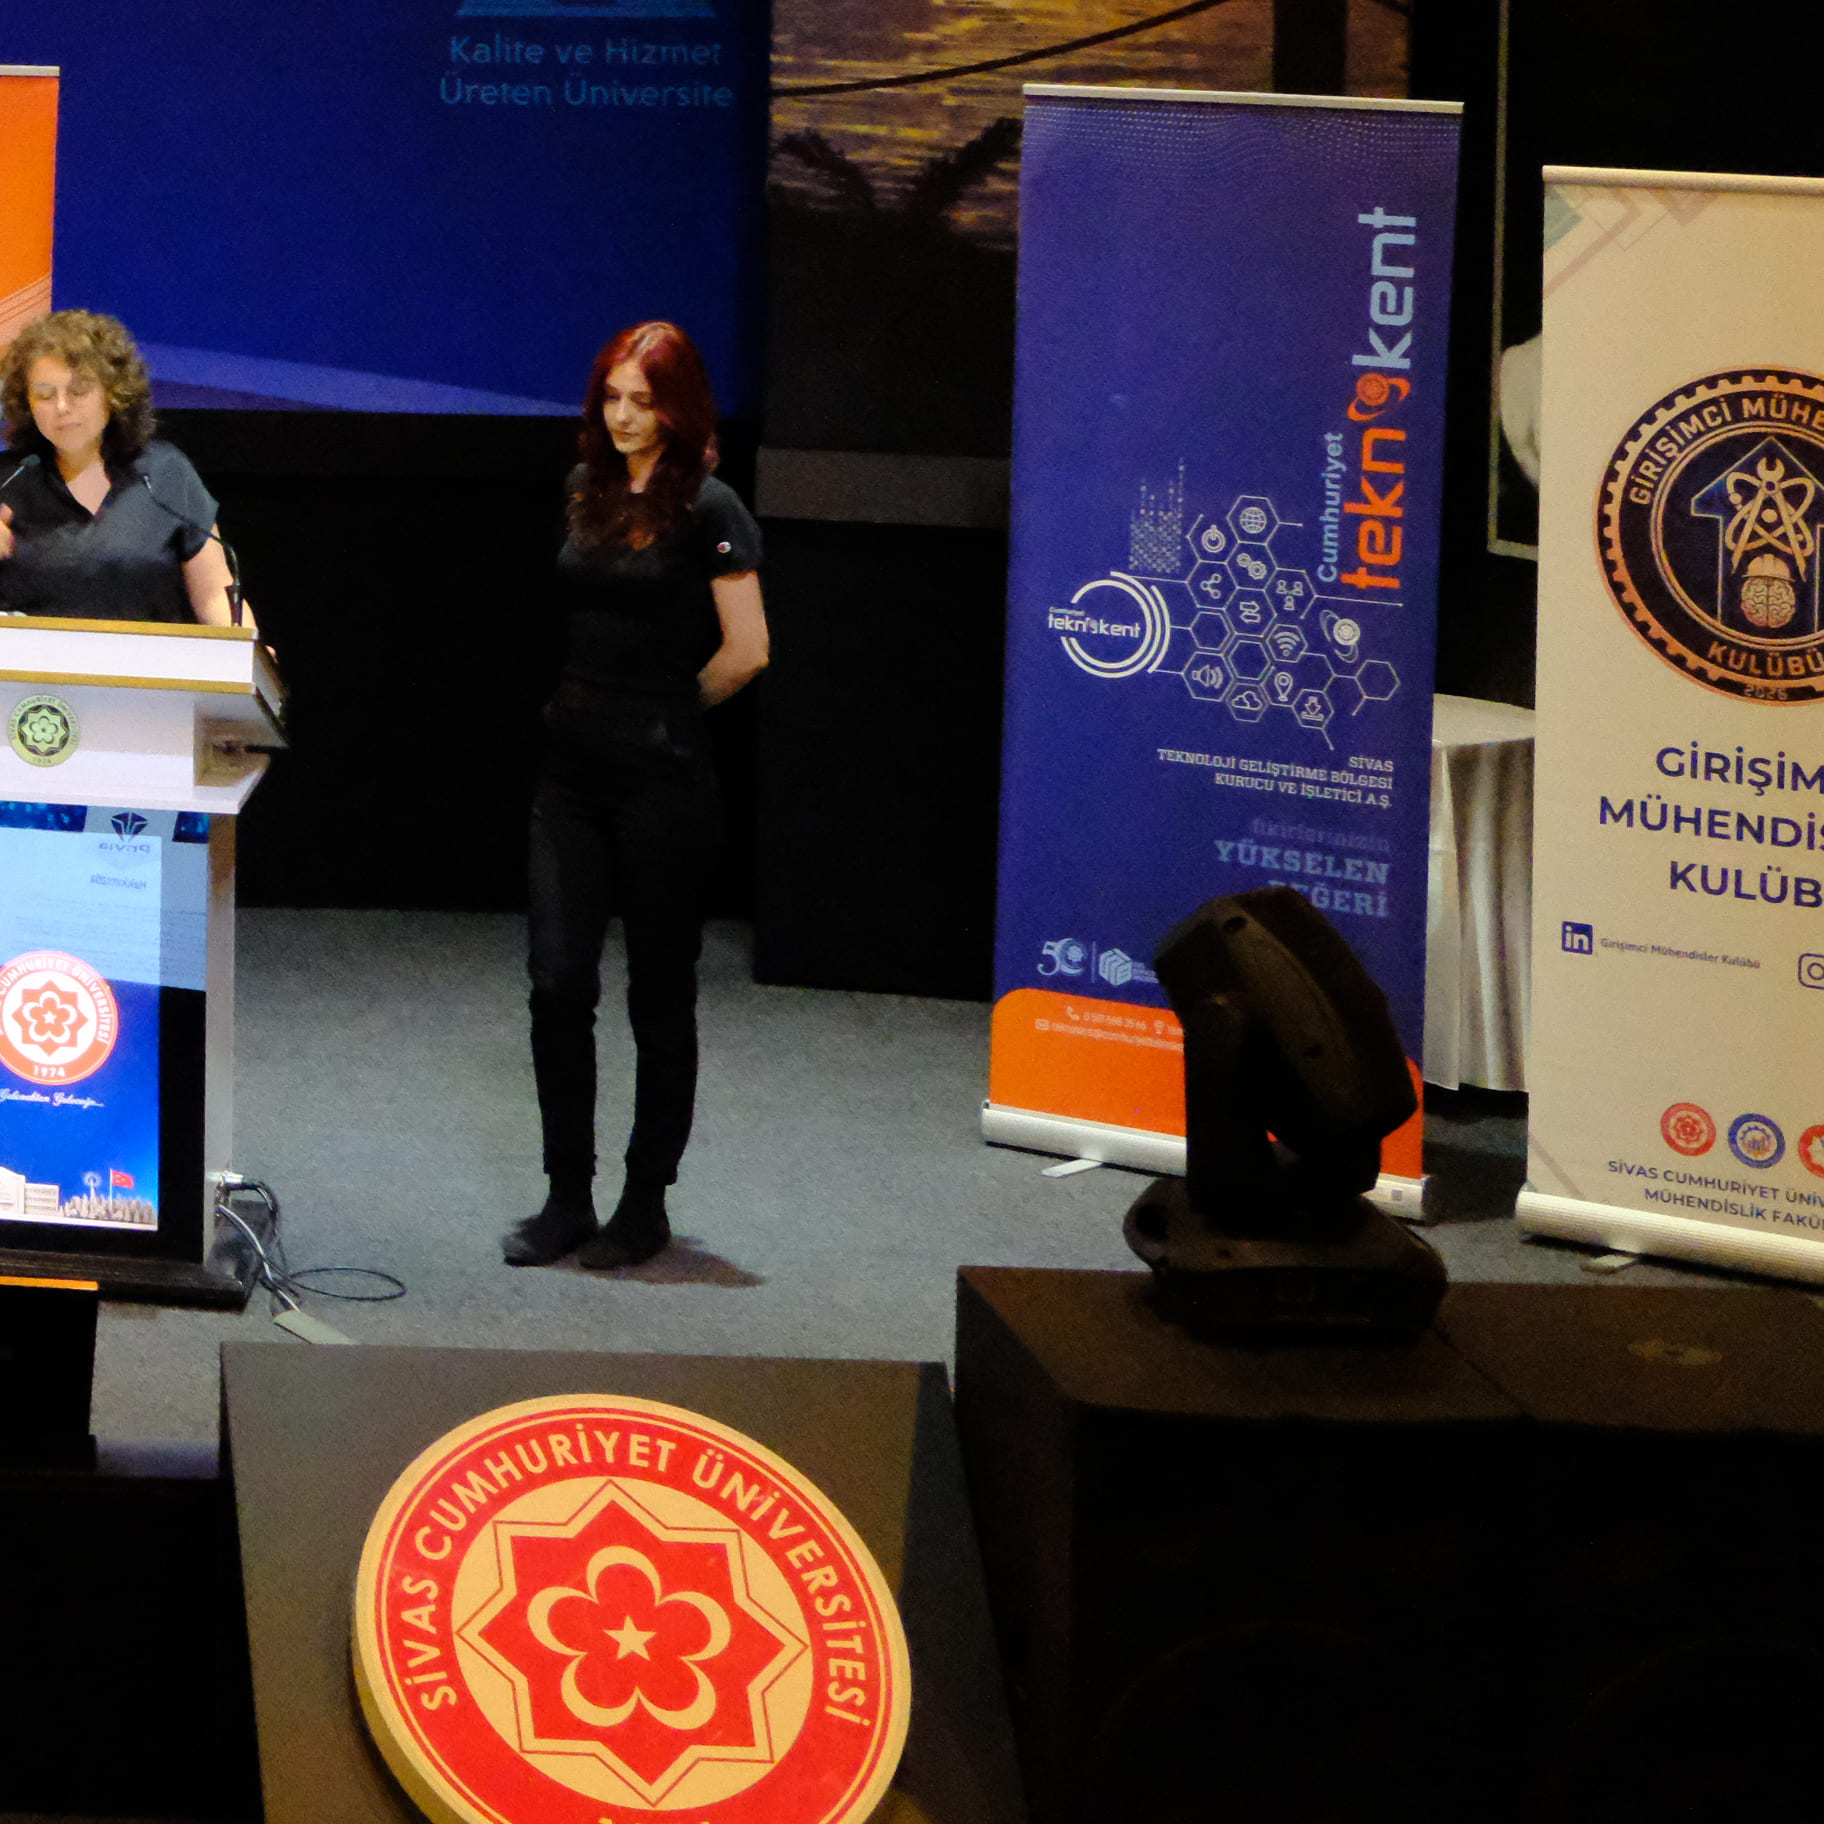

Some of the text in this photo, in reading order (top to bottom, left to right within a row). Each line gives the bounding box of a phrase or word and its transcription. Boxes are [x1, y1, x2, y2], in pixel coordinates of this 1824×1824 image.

[449, 35, 721, 67] Kalite ve Hizmet
[439, 71, 733, 110] Üreten Üniversite
[1628, 397, 1732, 505] GİRİŞİMCİ
[1316, 431, 1348, 584] Cumhuriyet
[1707, 640, 1824, 676] KULÜBÜ
[1156, 747, 1394, 791] TEKNOLOJİ GELİŞTİRME BÖLGESİ
[1348, 753, 1395, 774] SİVAS
[1214, 772, 1275, 794] KURUCU
[1277, 779, 1298, 796] VE
[1299, 781, 1363, 805] İŞLETİCİ
[1213, 837, 1391, 885] YÜKSELEN
[33, 1064, 66, 1078] 1974
[1608, 1159, 1659, 1180] SİVAS
[1662, 1168, 1780, 1201] CUMHURİYET
[1643, 1187, 1767, 1221] MÜHENDİSLİK
[401, 1423, 871, 1727] SİVAS CUMHURİYET ÜNİVERSİTESİ
